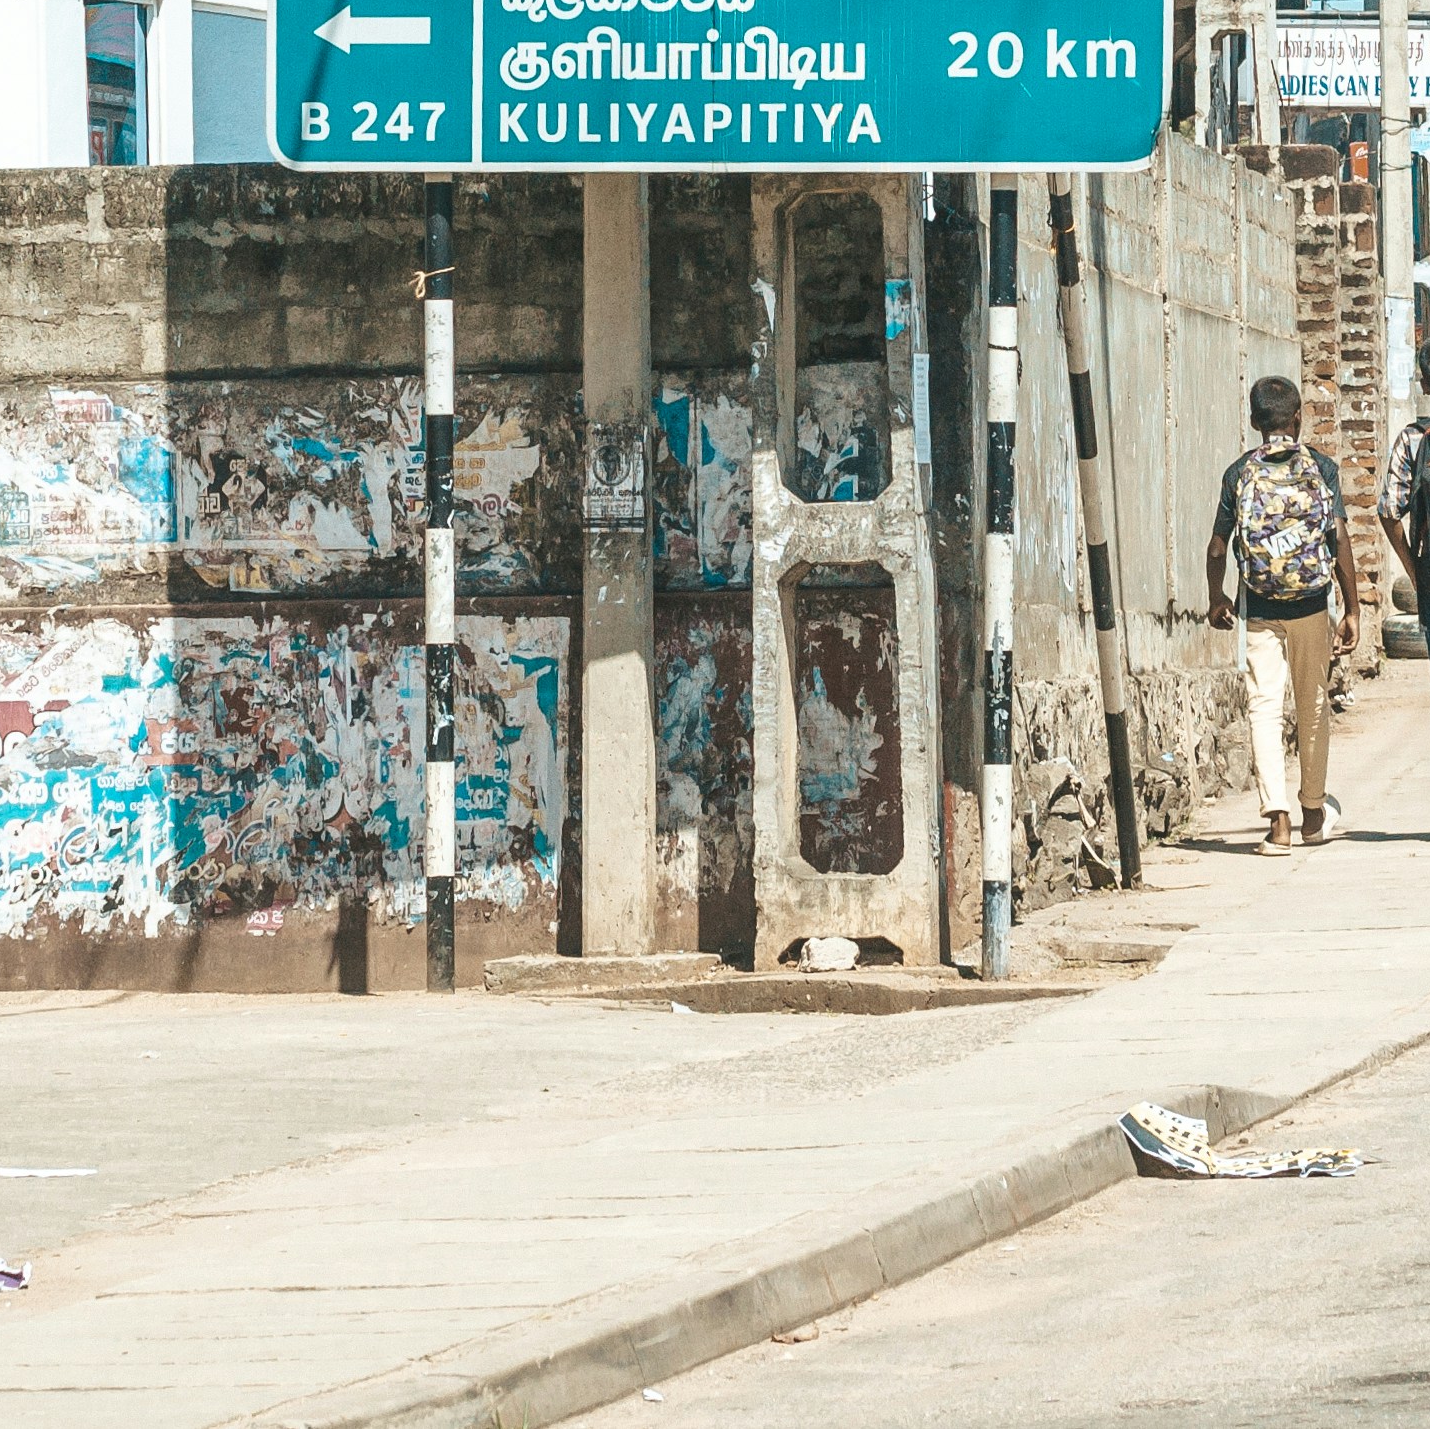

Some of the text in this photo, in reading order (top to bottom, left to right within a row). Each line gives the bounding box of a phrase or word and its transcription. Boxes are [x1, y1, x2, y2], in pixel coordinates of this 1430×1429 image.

[499, 25, 866, 91] குளியாப்பிடிய
[947, 29, 1137, 79] 20 km
[1279, 74, 1329, 97] ADIES
[1334, 74, 1370, 97] CAN
[301, 102, 446, 142] B 247
[499, 102, 881, 143] KULIYAPITIYA
[1259, 519, 1311, 560] VANS
